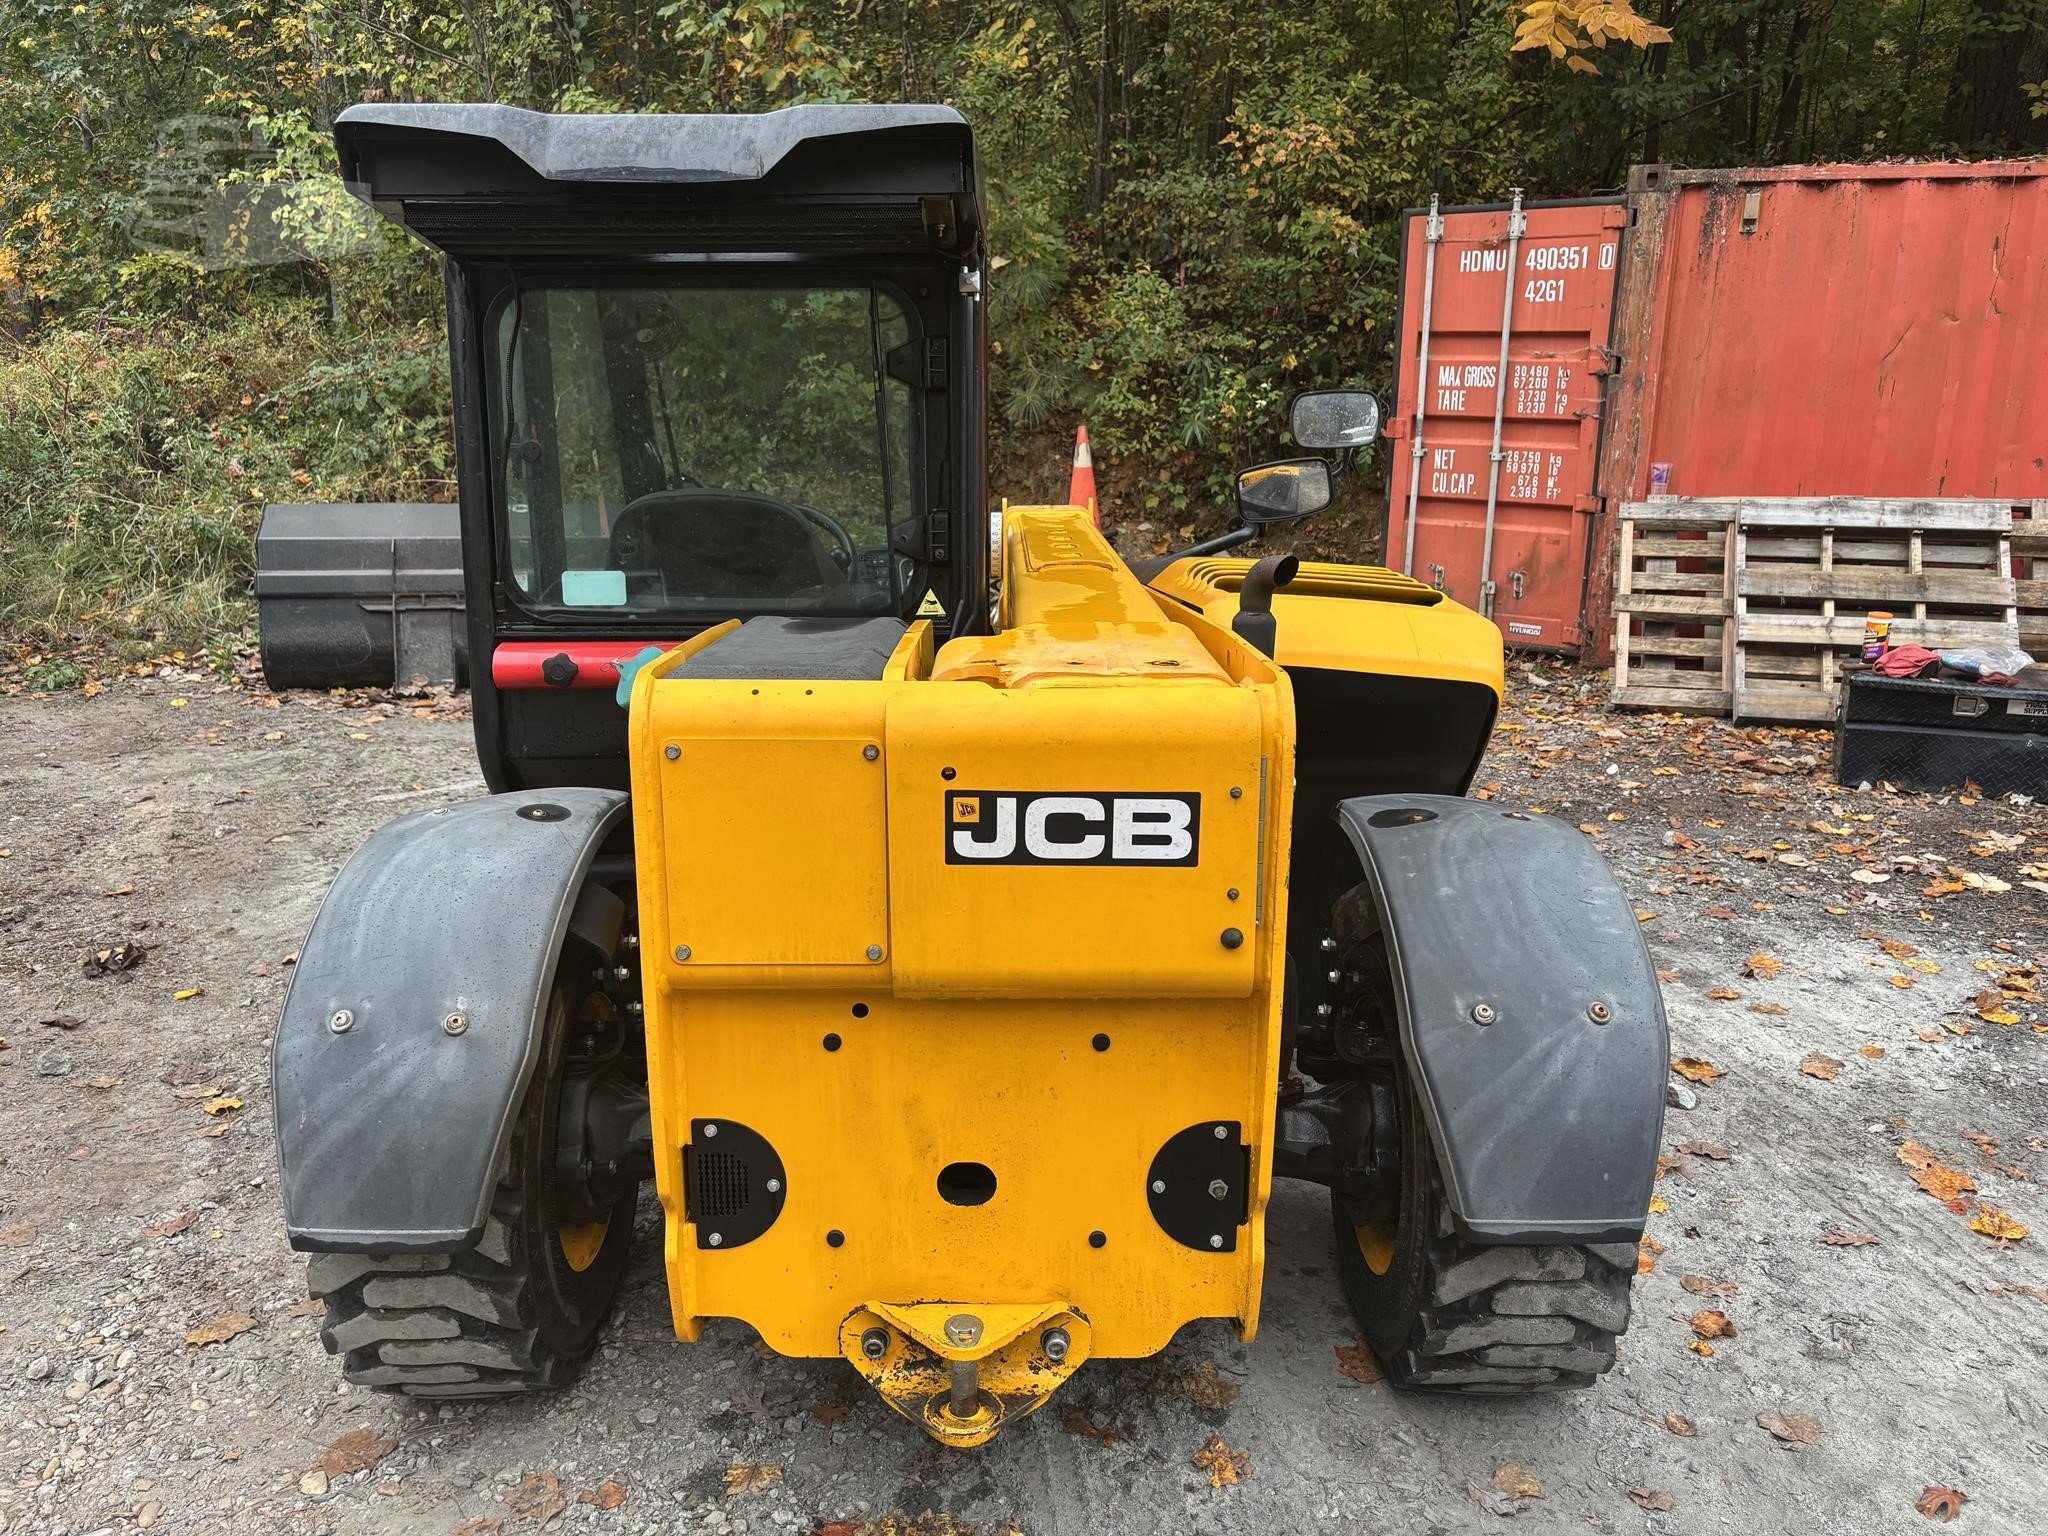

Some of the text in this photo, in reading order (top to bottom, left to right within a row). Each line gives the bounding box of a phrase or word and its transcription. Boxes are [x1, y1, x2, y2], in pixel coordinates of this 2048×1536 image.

[1459, 244, 1614, 272] HDMU 490351 0
[1524, 279, 1565, 303] 42G1
[1463, 365, 1497, 388] GROSS
[1514, 365, 1571, 380] 30,480 kg
[1513, 377, 1567, 389] 67,200 lb
[1437, 389, 1466, 411] TARE
[1518, 389, 1568, 406] 3,730 kg
[1517, 402, 1565, 414] 8,230 lb
[1433, 448, 1456, 470] NET
[1506, 450, 1563, 468] 26,750 kg
[1505, 462, 1559, 476] 58,970 lb
[1517, 475, 1539, 488] 67.6
[1510, 486, 1538, 499] 2,389
[959, 803, 977, 816] JCB
[952, 797, 1192, 859] JCB
